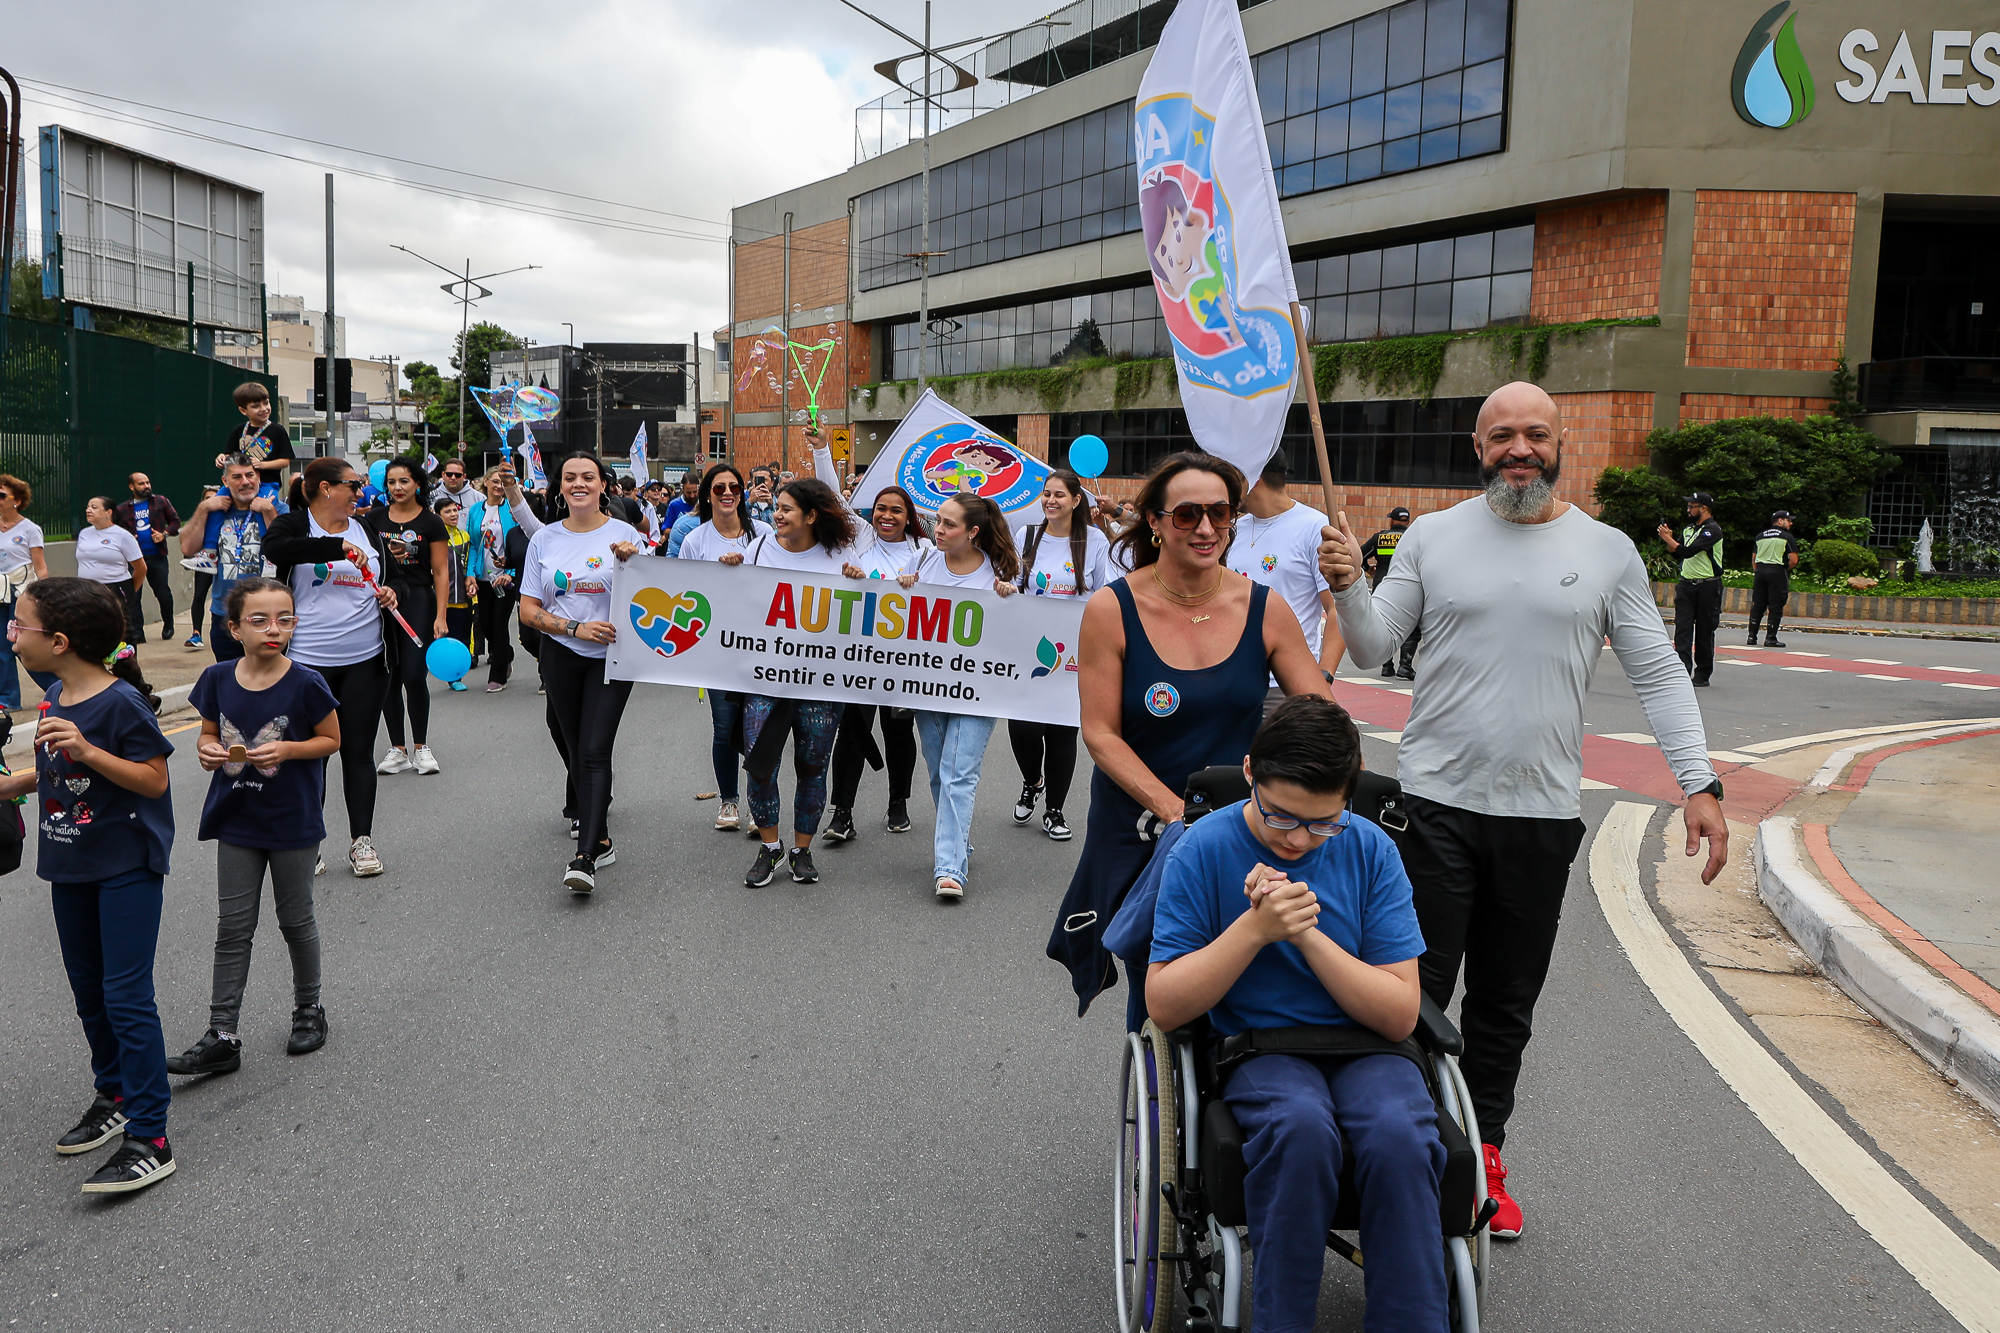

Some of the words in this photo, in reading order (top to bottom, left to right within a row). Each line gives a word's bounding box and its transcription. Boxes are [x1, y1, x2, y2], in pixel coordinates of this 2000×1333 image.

[1835, 28, 2000, 106] SAES
[904, 464, 916, 477] da
[908, 445, 927, 464] Mês
[999, 489, 1031, 509] utismo
[765, 582, 984, 647] AUTISMO
[720, 630, 767, 652] Uma
[774, 637, 836, 660] forma
[843, 643, 943, 669] diferente
[950, 654, 976, 673] de
[982, 660, 1020, 680] ser,
[754, 666, 816, 685] sentir
[823, 673, 835, 686] e
[842, 674, 877, 690] ver
[883, 678, 895, 691] o
[902, 681, 980, 702] mundo.
